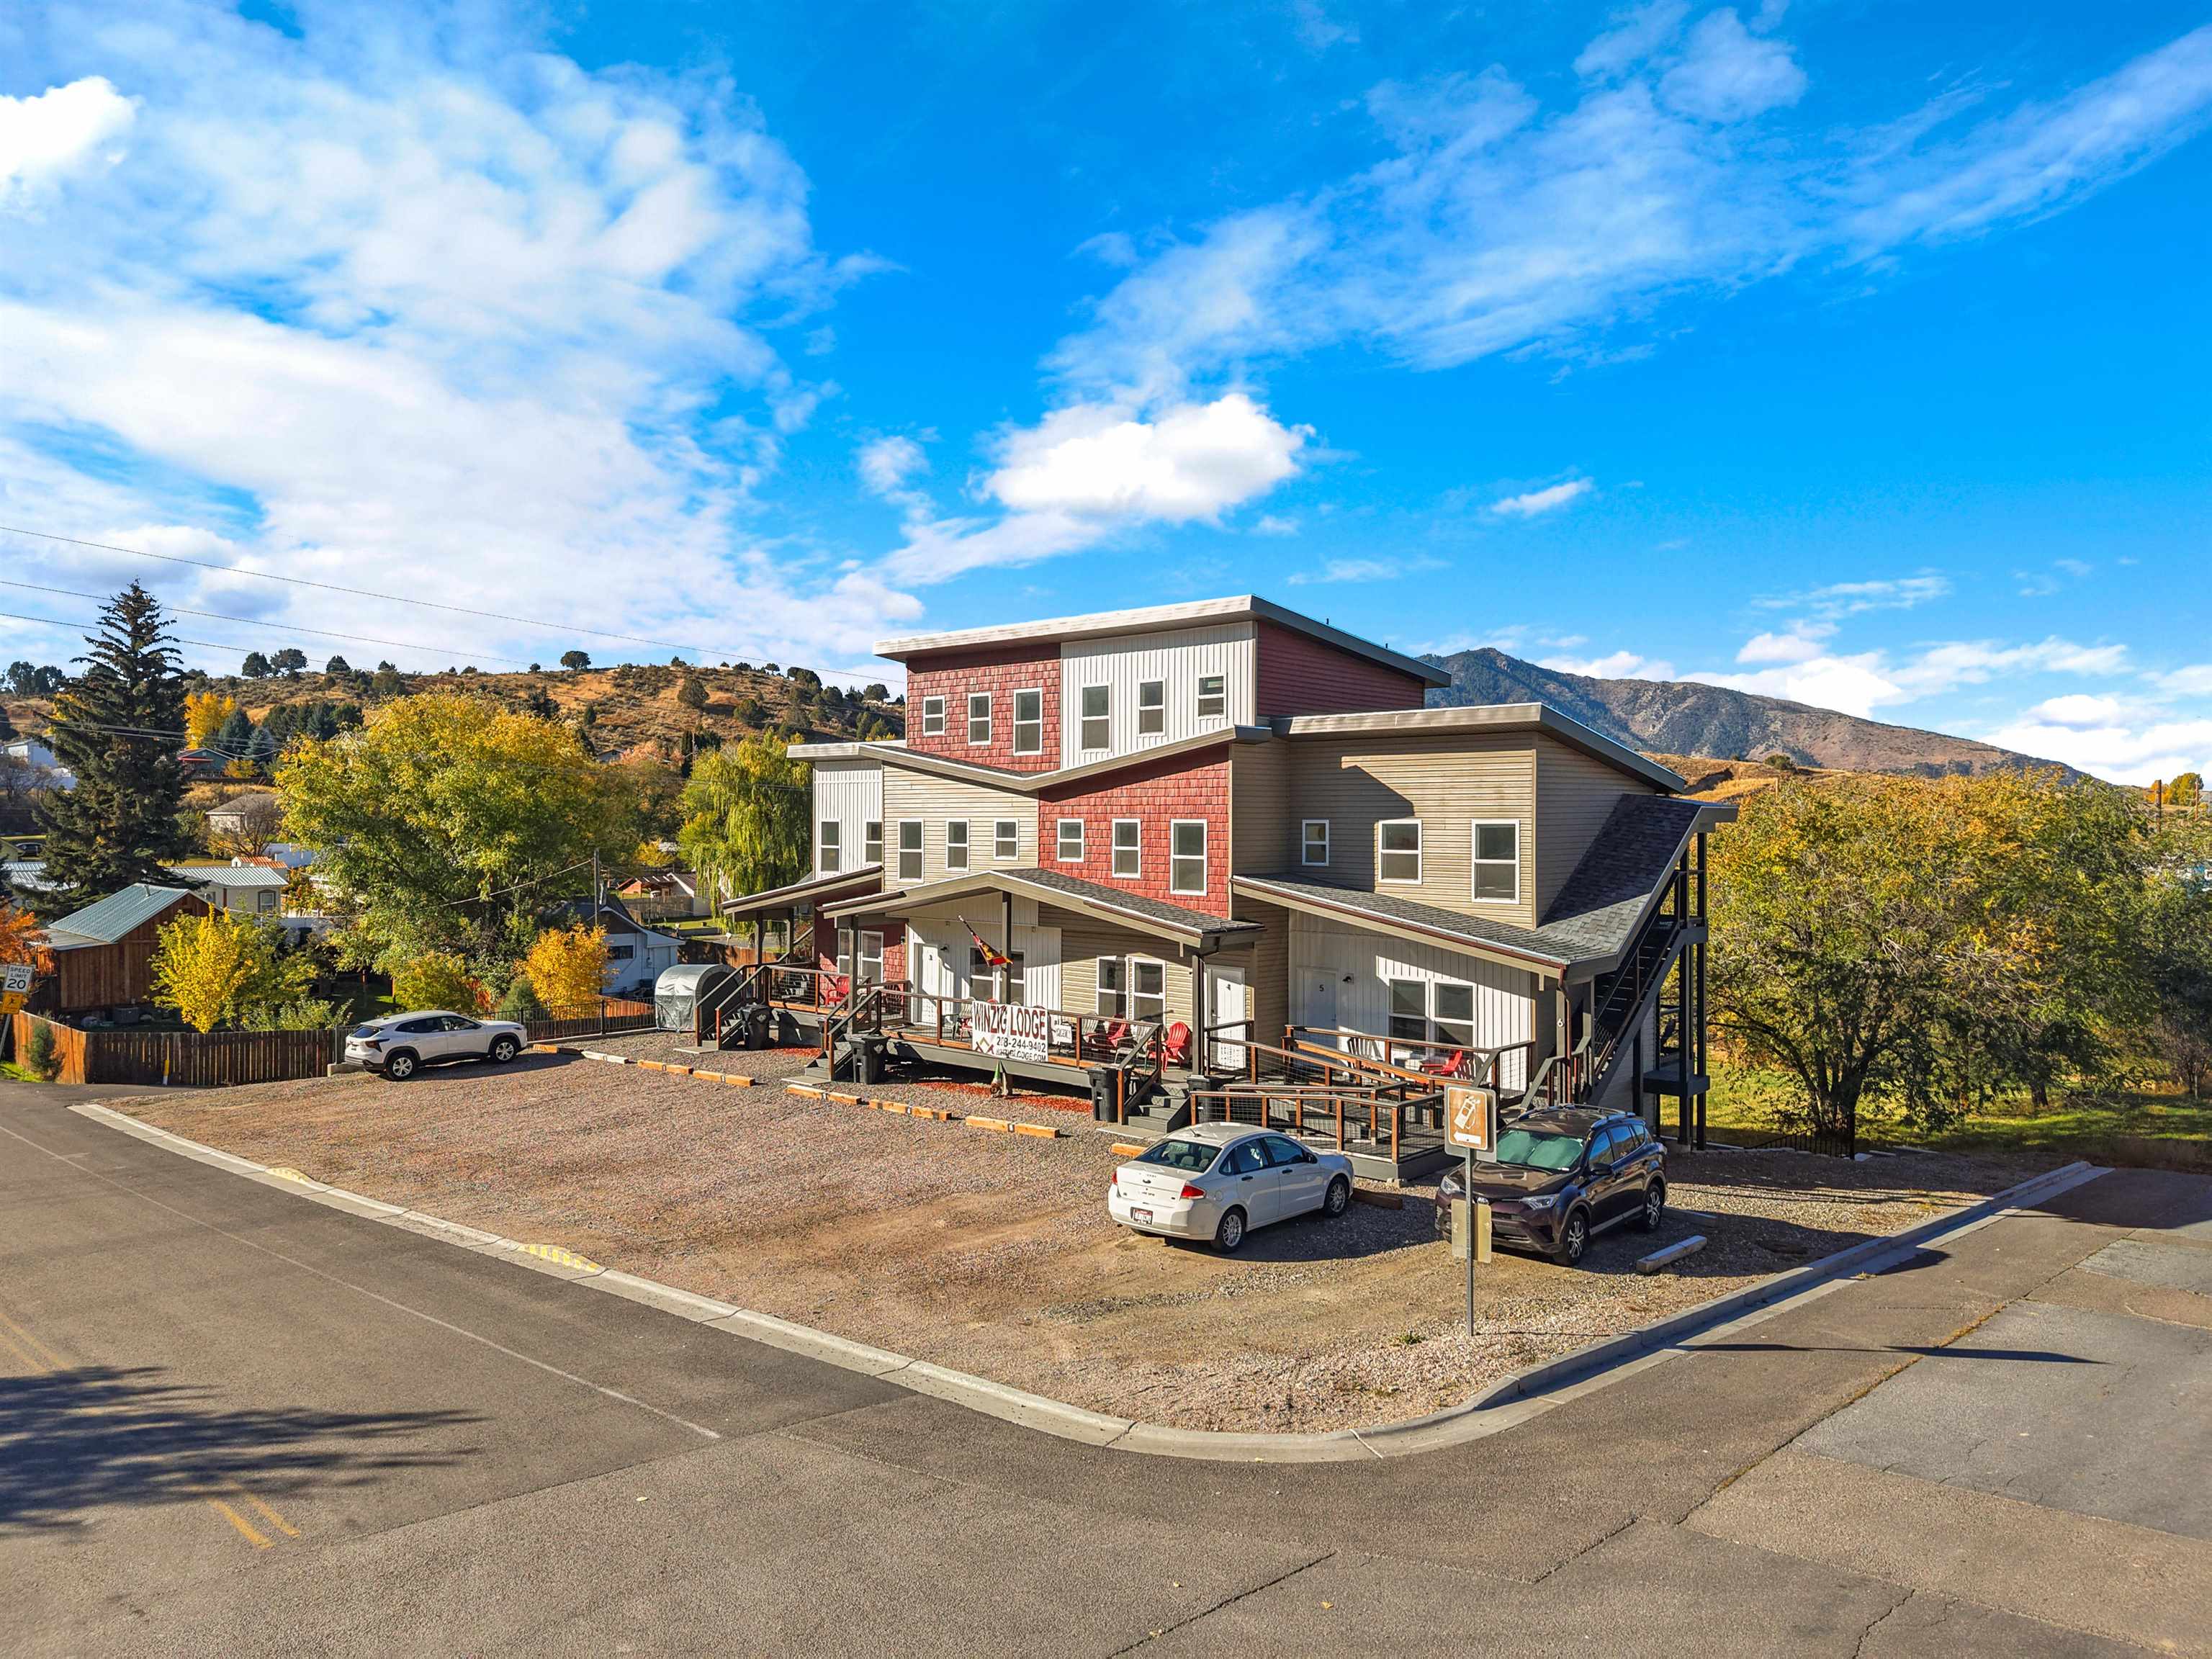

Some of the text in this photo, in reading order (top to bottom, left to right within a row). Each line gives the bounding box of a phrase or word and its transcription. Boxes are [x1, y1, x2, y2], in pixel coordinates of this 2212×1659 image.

[7, 979, 26, 989] 20
[974, 1002, 1046, 1040] WINZIG LODGE
